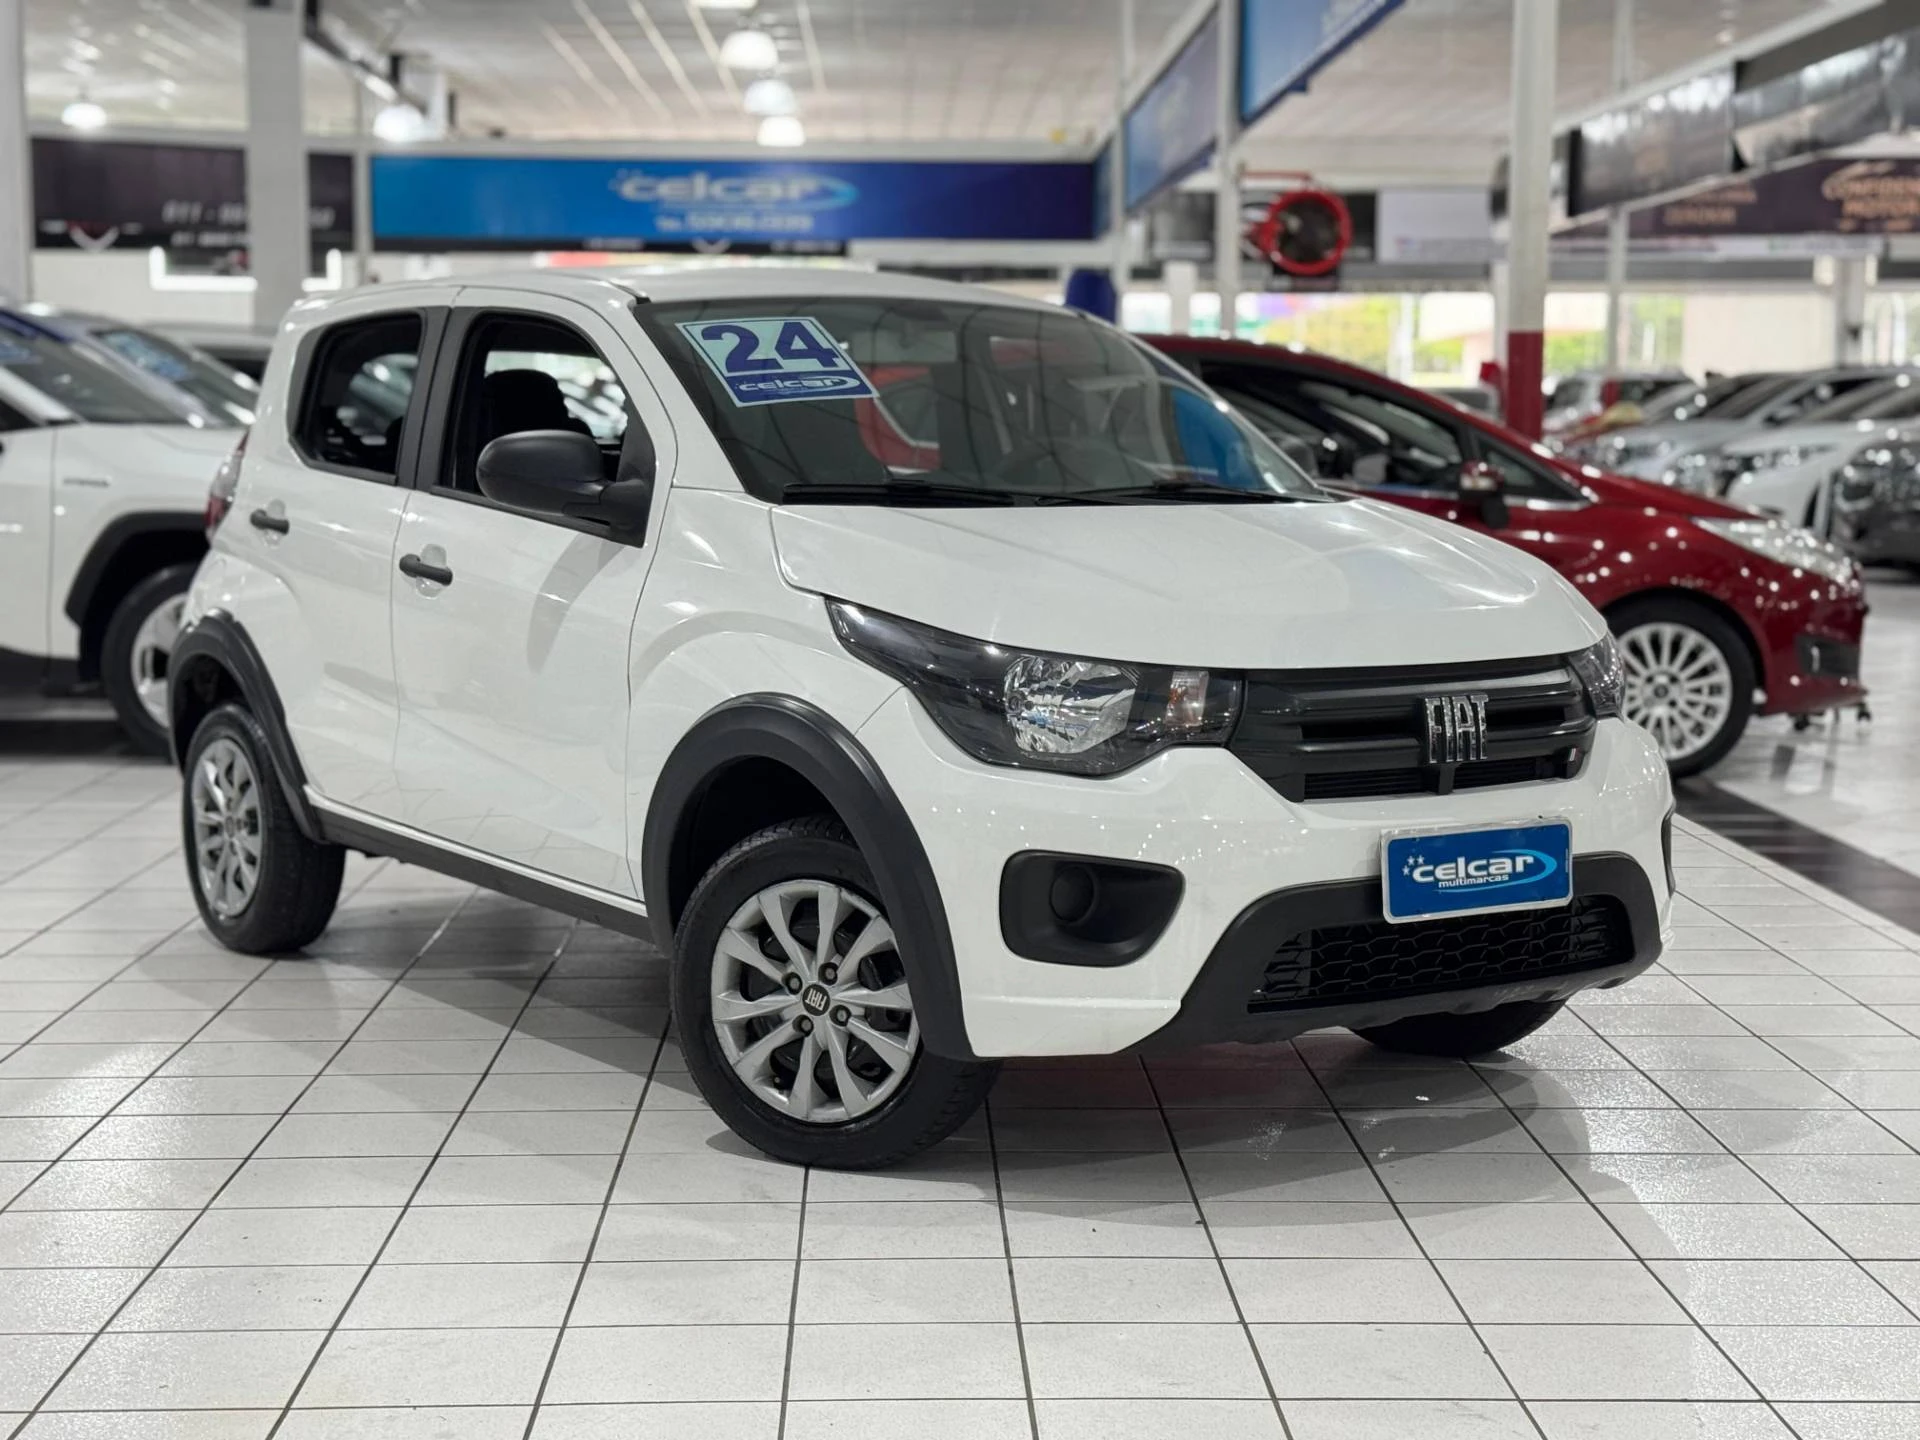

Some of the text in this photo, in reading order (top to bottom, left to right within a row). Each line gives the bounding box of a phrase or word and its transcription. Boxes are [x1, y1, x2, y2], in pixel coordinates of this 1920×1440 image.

[620, 170, 817, 203] celcar
[701, 321, 840, 373] 24
[738, 376, 842, 392] celcar
[1425, 693, 1490, 763] FIAT
[1412, 855, 1535, 883] celcar
[1437, 873, 1510, 889] multimarcas
[804, 988, 828, 1011] FIAT
